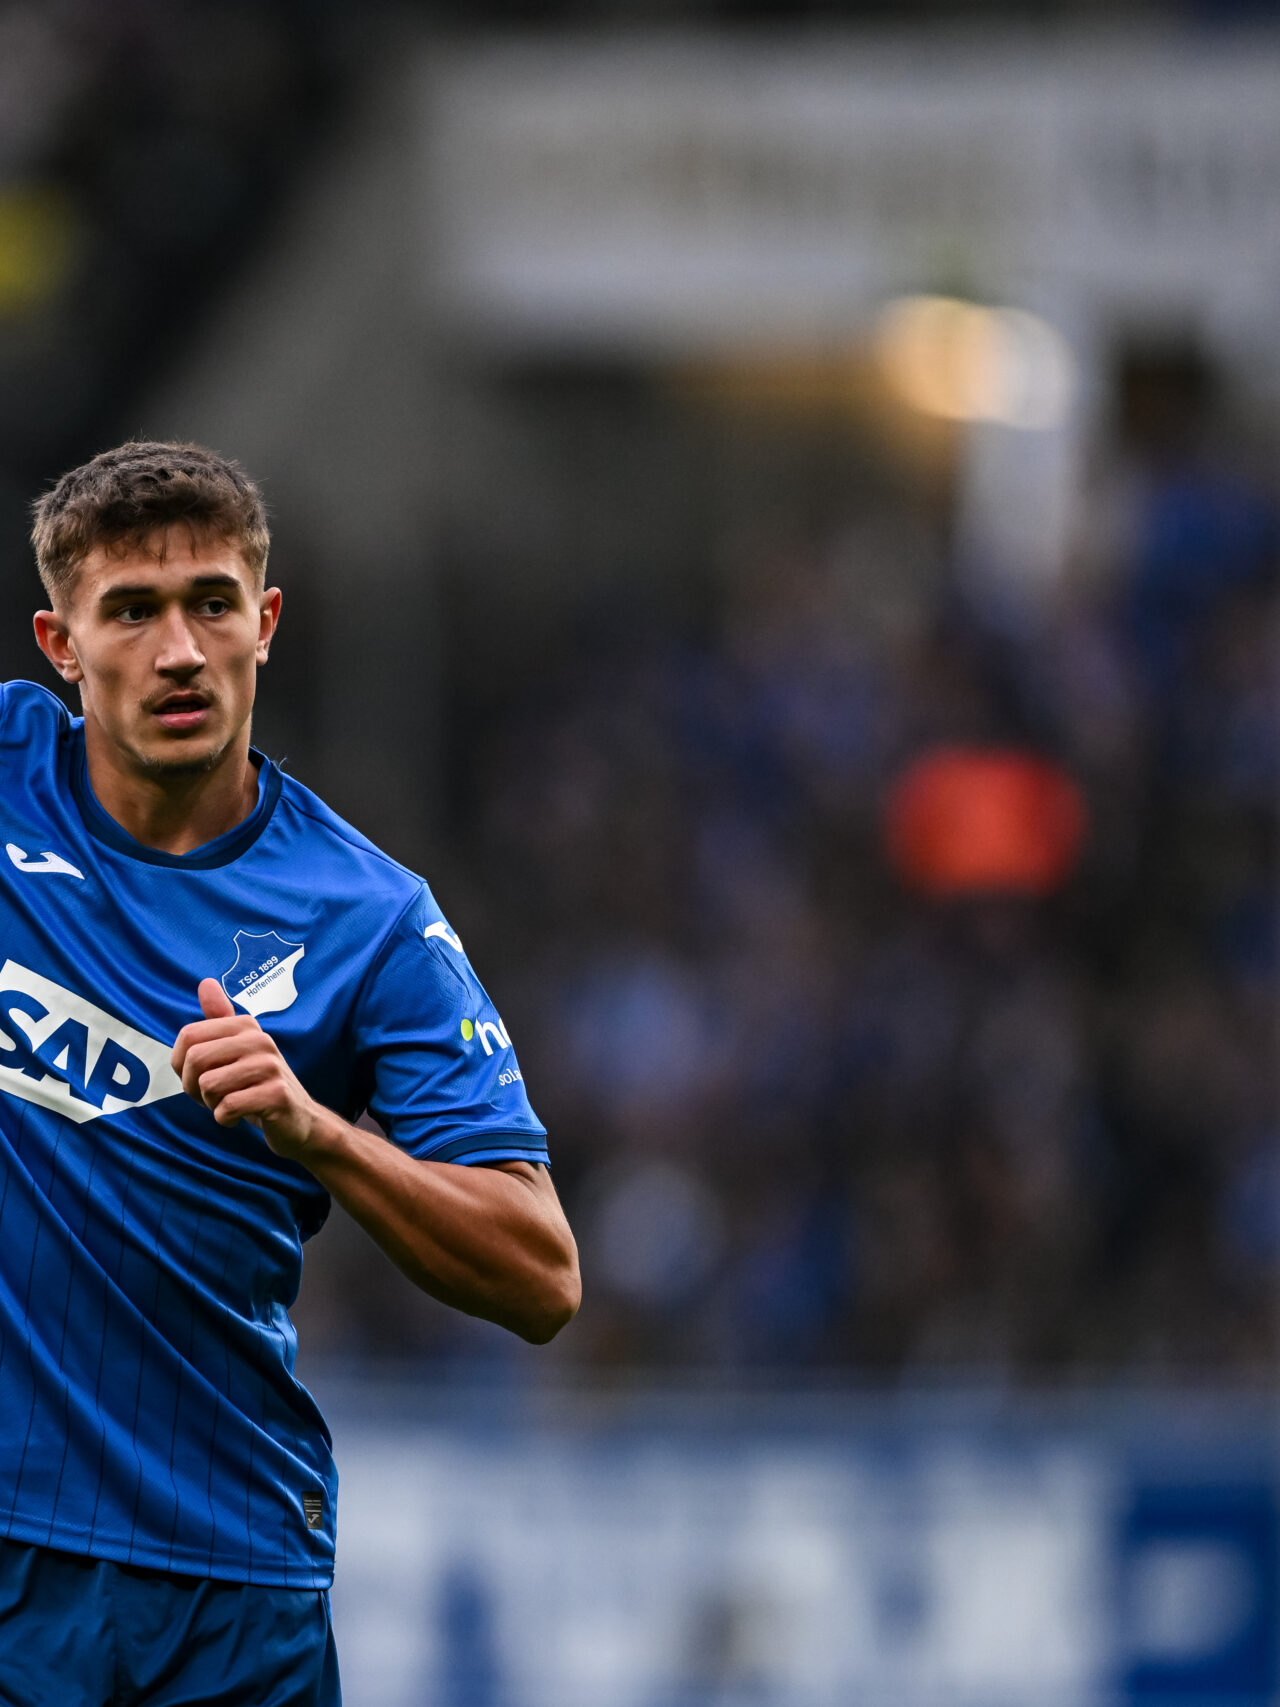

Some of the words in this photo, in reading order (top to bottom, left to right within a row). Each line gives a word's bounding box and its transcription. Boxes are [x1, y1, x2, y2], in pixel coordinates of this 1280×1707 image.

[237, 970, 259, 988] TSG
[258, 955, 279, 973] 1899
[246, 965, 286, 998] Hoffenheim
